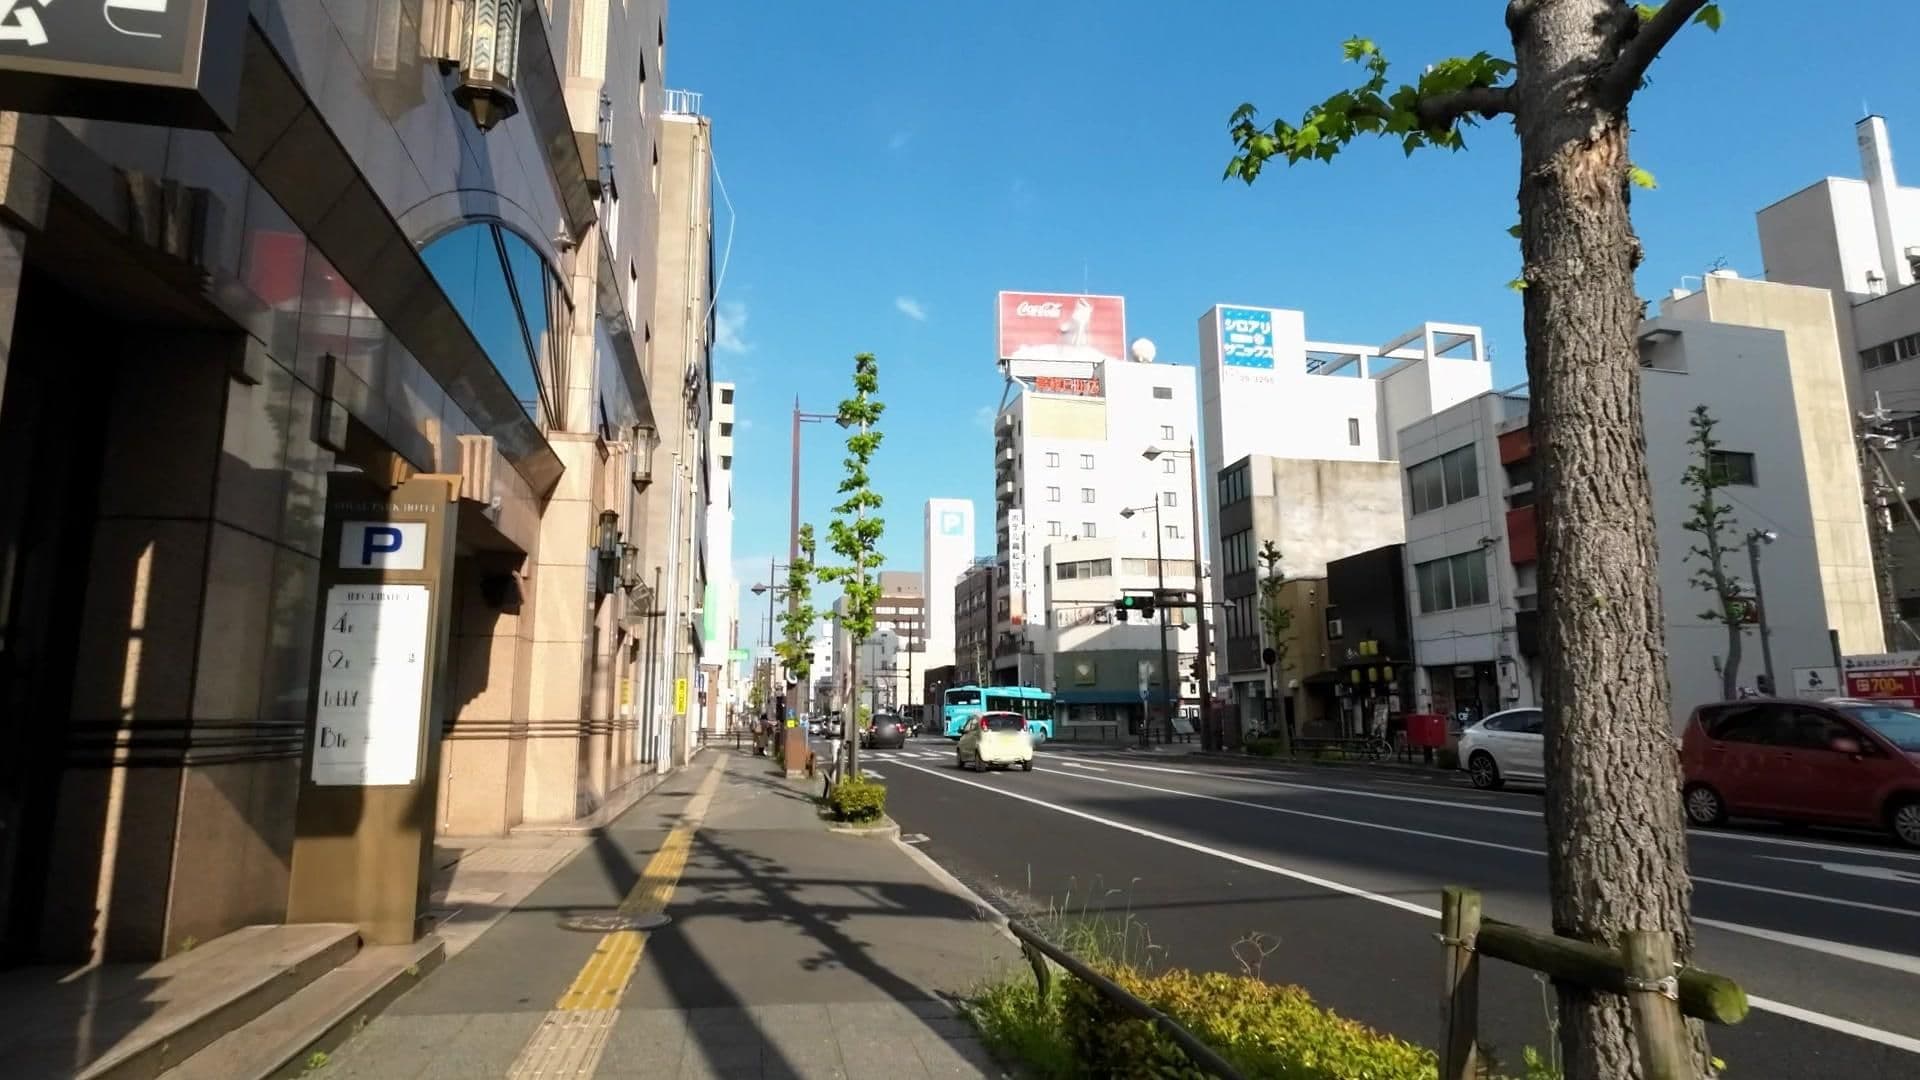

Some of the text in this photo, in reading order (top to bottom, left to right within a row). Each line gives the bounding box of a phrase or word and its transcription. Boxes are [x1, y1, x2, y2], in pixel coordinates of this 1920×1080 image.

[1224, 318, 1271, 335] シロアリ
[362, 526, 402, 566] P
